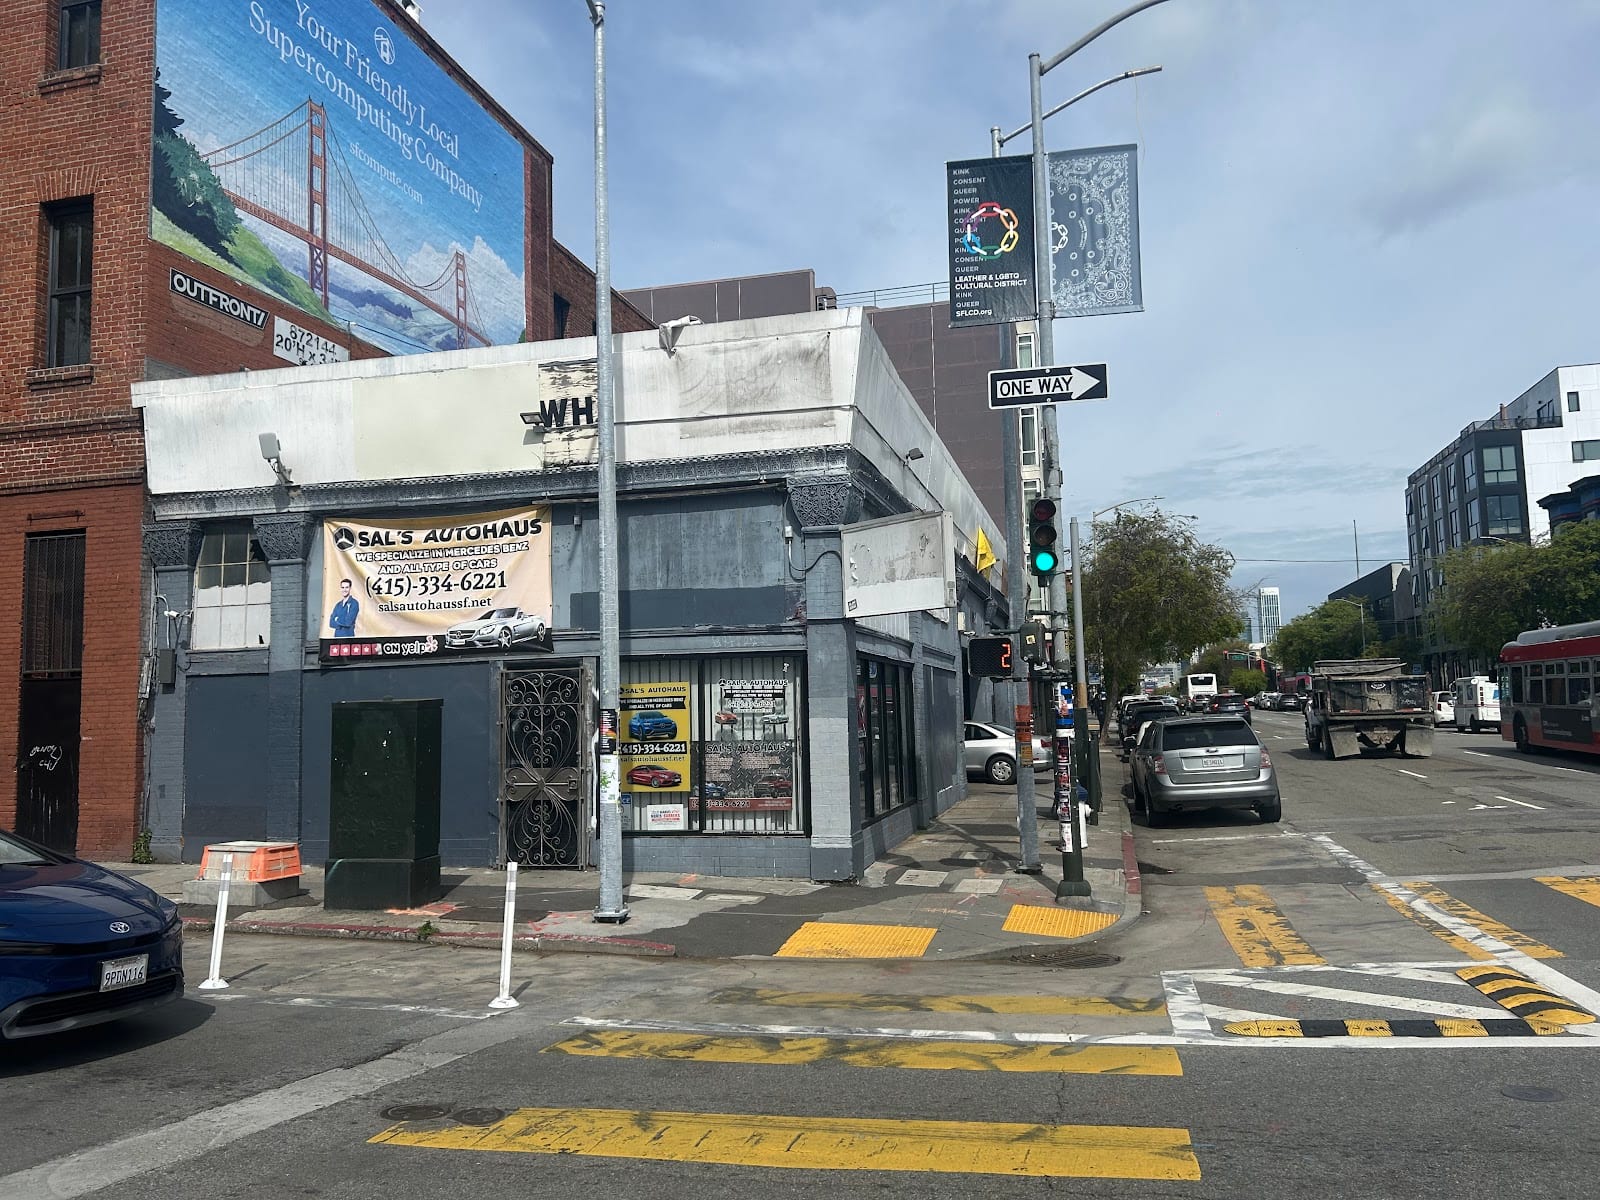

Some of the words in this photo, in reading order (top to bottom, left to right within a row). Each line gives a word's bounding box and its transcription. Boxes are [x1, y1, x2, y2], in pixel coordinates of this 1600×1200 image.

[296, 0, 343, 58] Your
[344, 38, 417, 126] Friendly
[419, 104, 460, 160] Local
[249, 1, 414, 160] Supercomputing
[414, 137, 483, 213] Company
[350, 142, 423, 205] sfcompute.com
[953, 177, 986, 185] CONSENT
[953, 187, 977, 195] QUEER
[953, 197, 980, 205] POWER
[954, 274, 987, 283] LEATHER
[995, 272, 1020, 281] LGBTQ
[955, 265, 979, 273] QUEER
[955, 281, 993, 290] CULTURAL
[994, 279, 1028, 288] DISTRICT
[955, 291, 973, 299] KINK
[955, 309, 993, 317] SFLCD.org
[289, 324, 337, 356] 872144
[999, 380, 1033, 397] ONE
[1038, 376, 1073, 394] WAY
[358, 529, 414, 547] SAL'S
[423, 518, 542, 544] AUTOHAUS
[355, 552, 373, 562] WE
[374, 549, 430, 561] SPECIALIZE
[431, 548, 443, 559] IN
[444, 544, 501, 557] MERCEDES
[502, 541, 529, 553] BENZ
[378, 564, 401, 575] AND
[402, 563, 422, 574] ALL
[422, 561, 449, 572] TYPE
[452, 560, 468, 571] OF
[469, 558, 498, 569] CARS
[365, 570, 508, 598] (415)-334-6221
[378, 597, 492, 614] salsautohaussf.net
[383, 642, 400, 655] ON
[401, 641, 426, 656] yelp
[1001, 643, 1011, 668] 2
[620, 742, 686, 754] (415)-334-6221
[104, 965, 145, 986] 9PDN116
